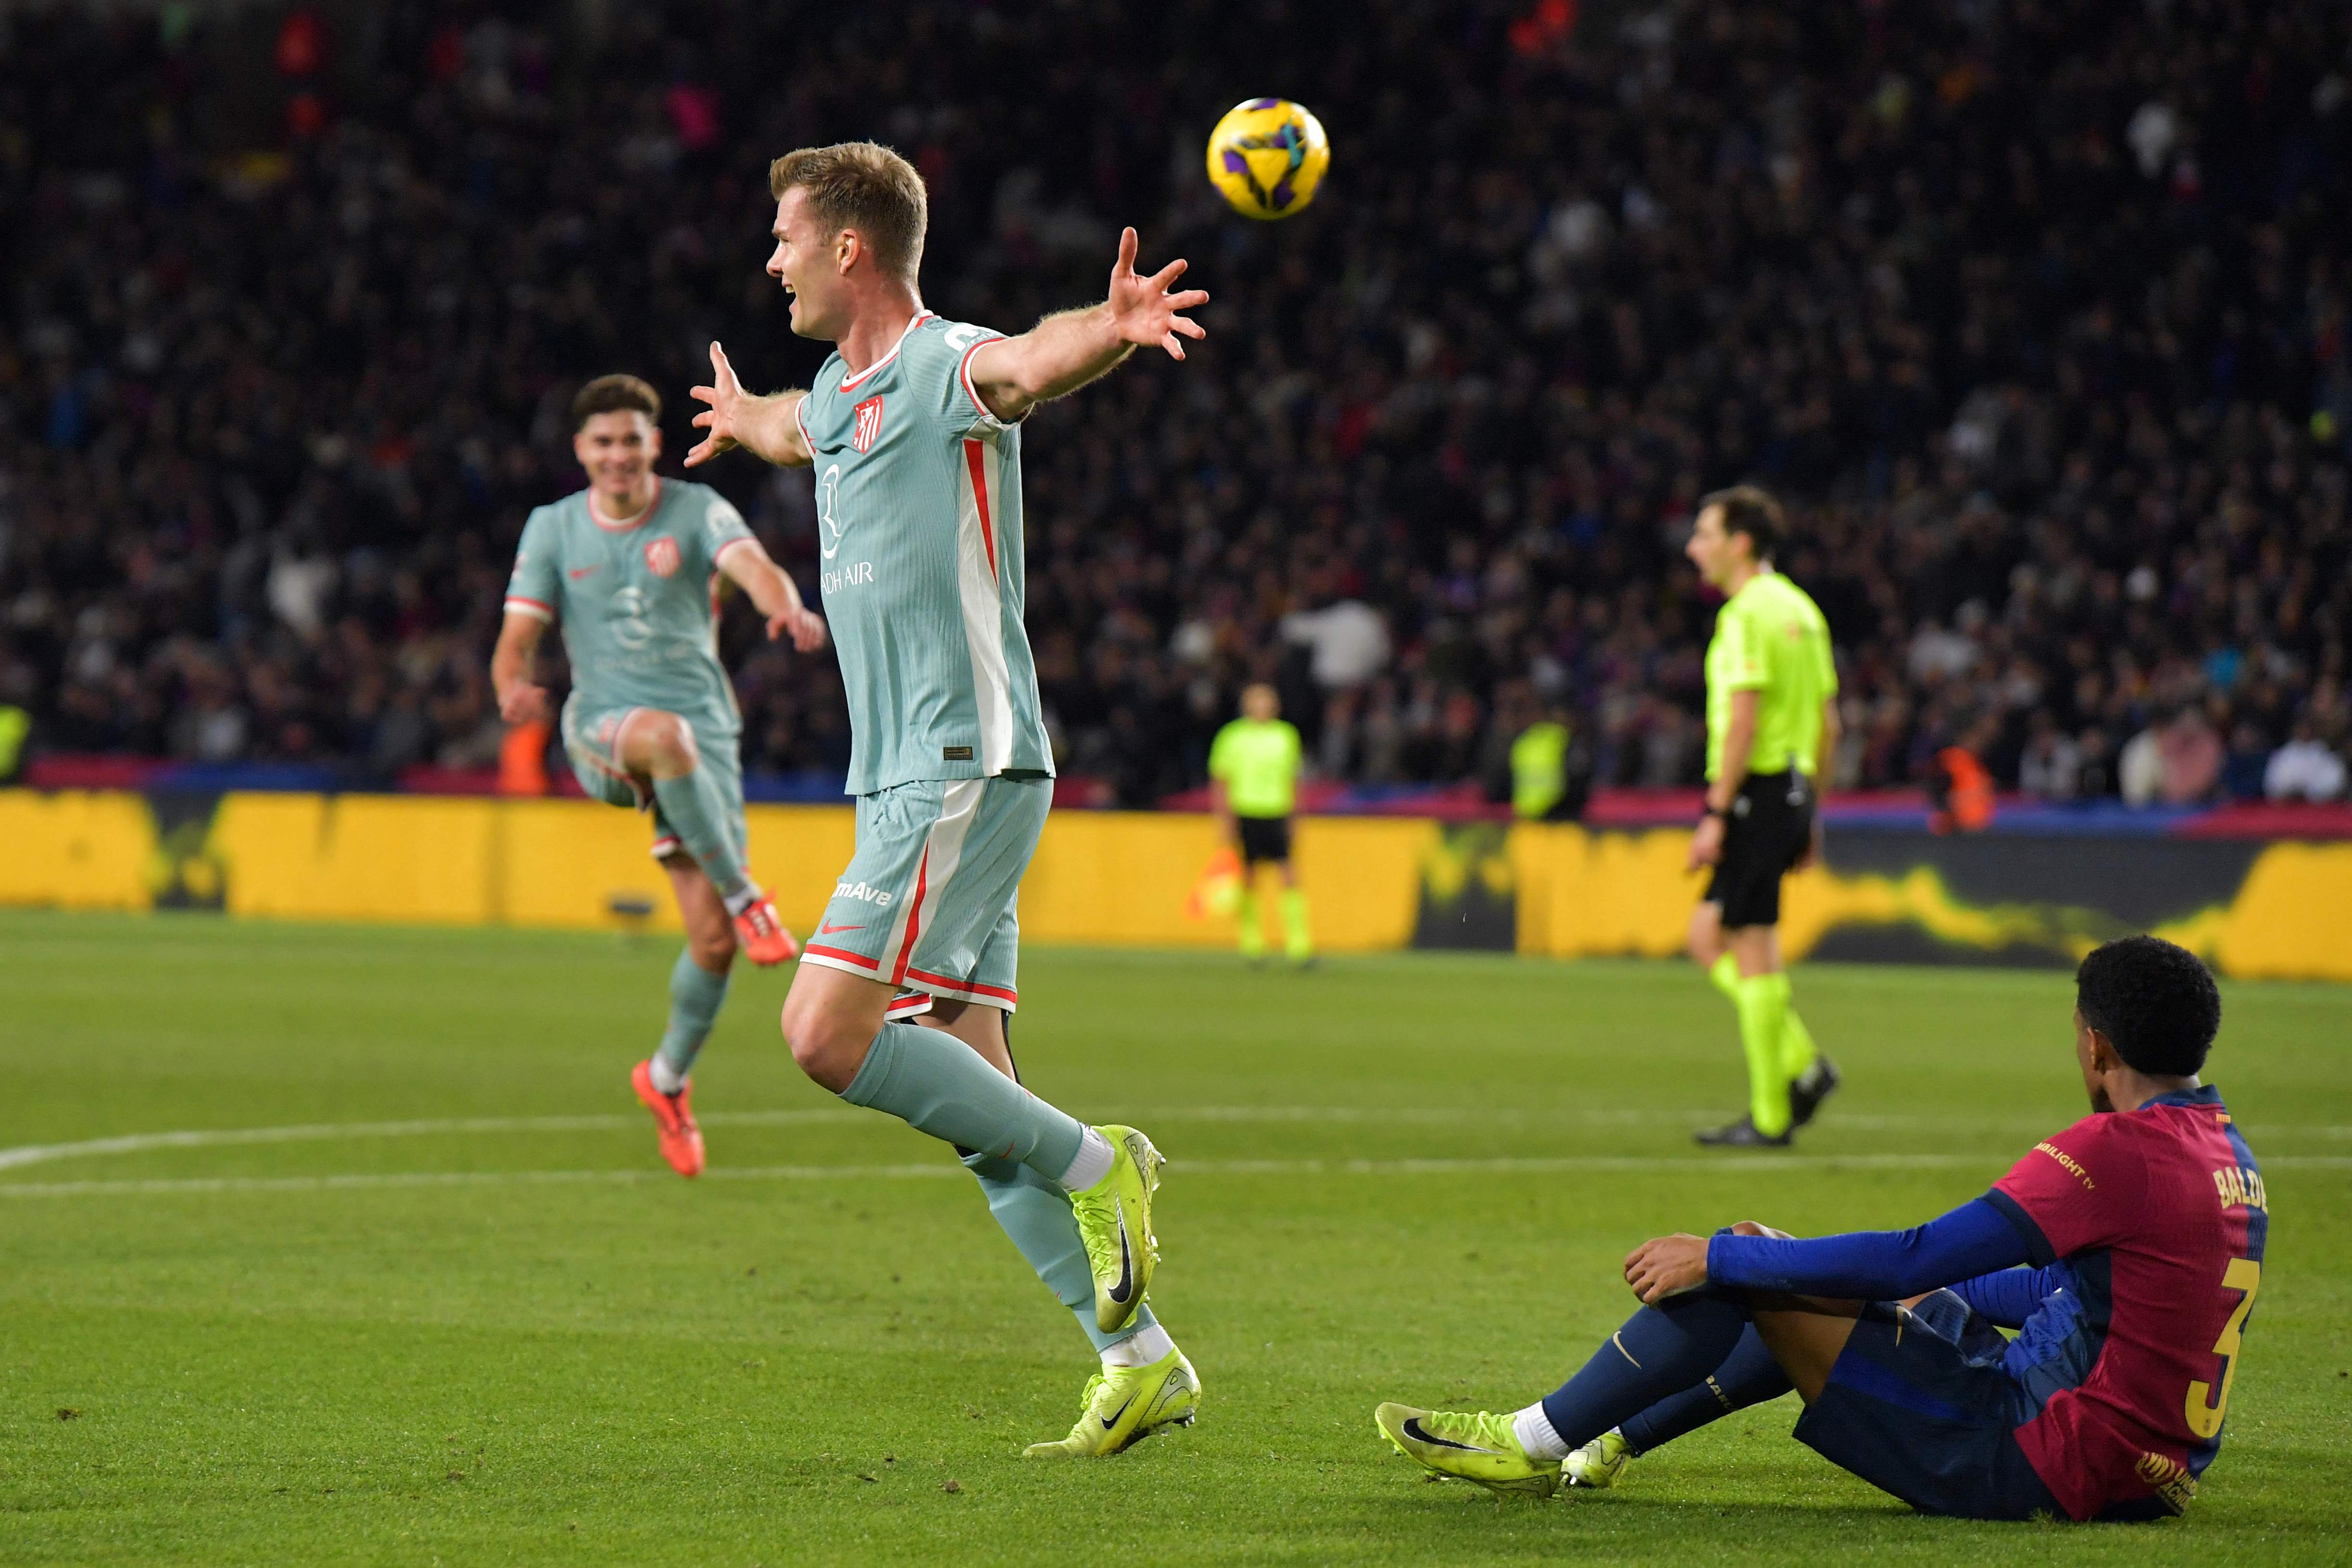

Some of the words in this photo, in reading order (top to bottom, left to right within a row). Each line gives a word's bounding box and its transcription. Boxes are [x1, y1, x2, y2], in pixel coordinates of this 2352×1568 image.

[845, 561, 874, 588] AIR
[831, 881, 892, 906] mAve
[2185, 1257, 2260, 1439] 3
